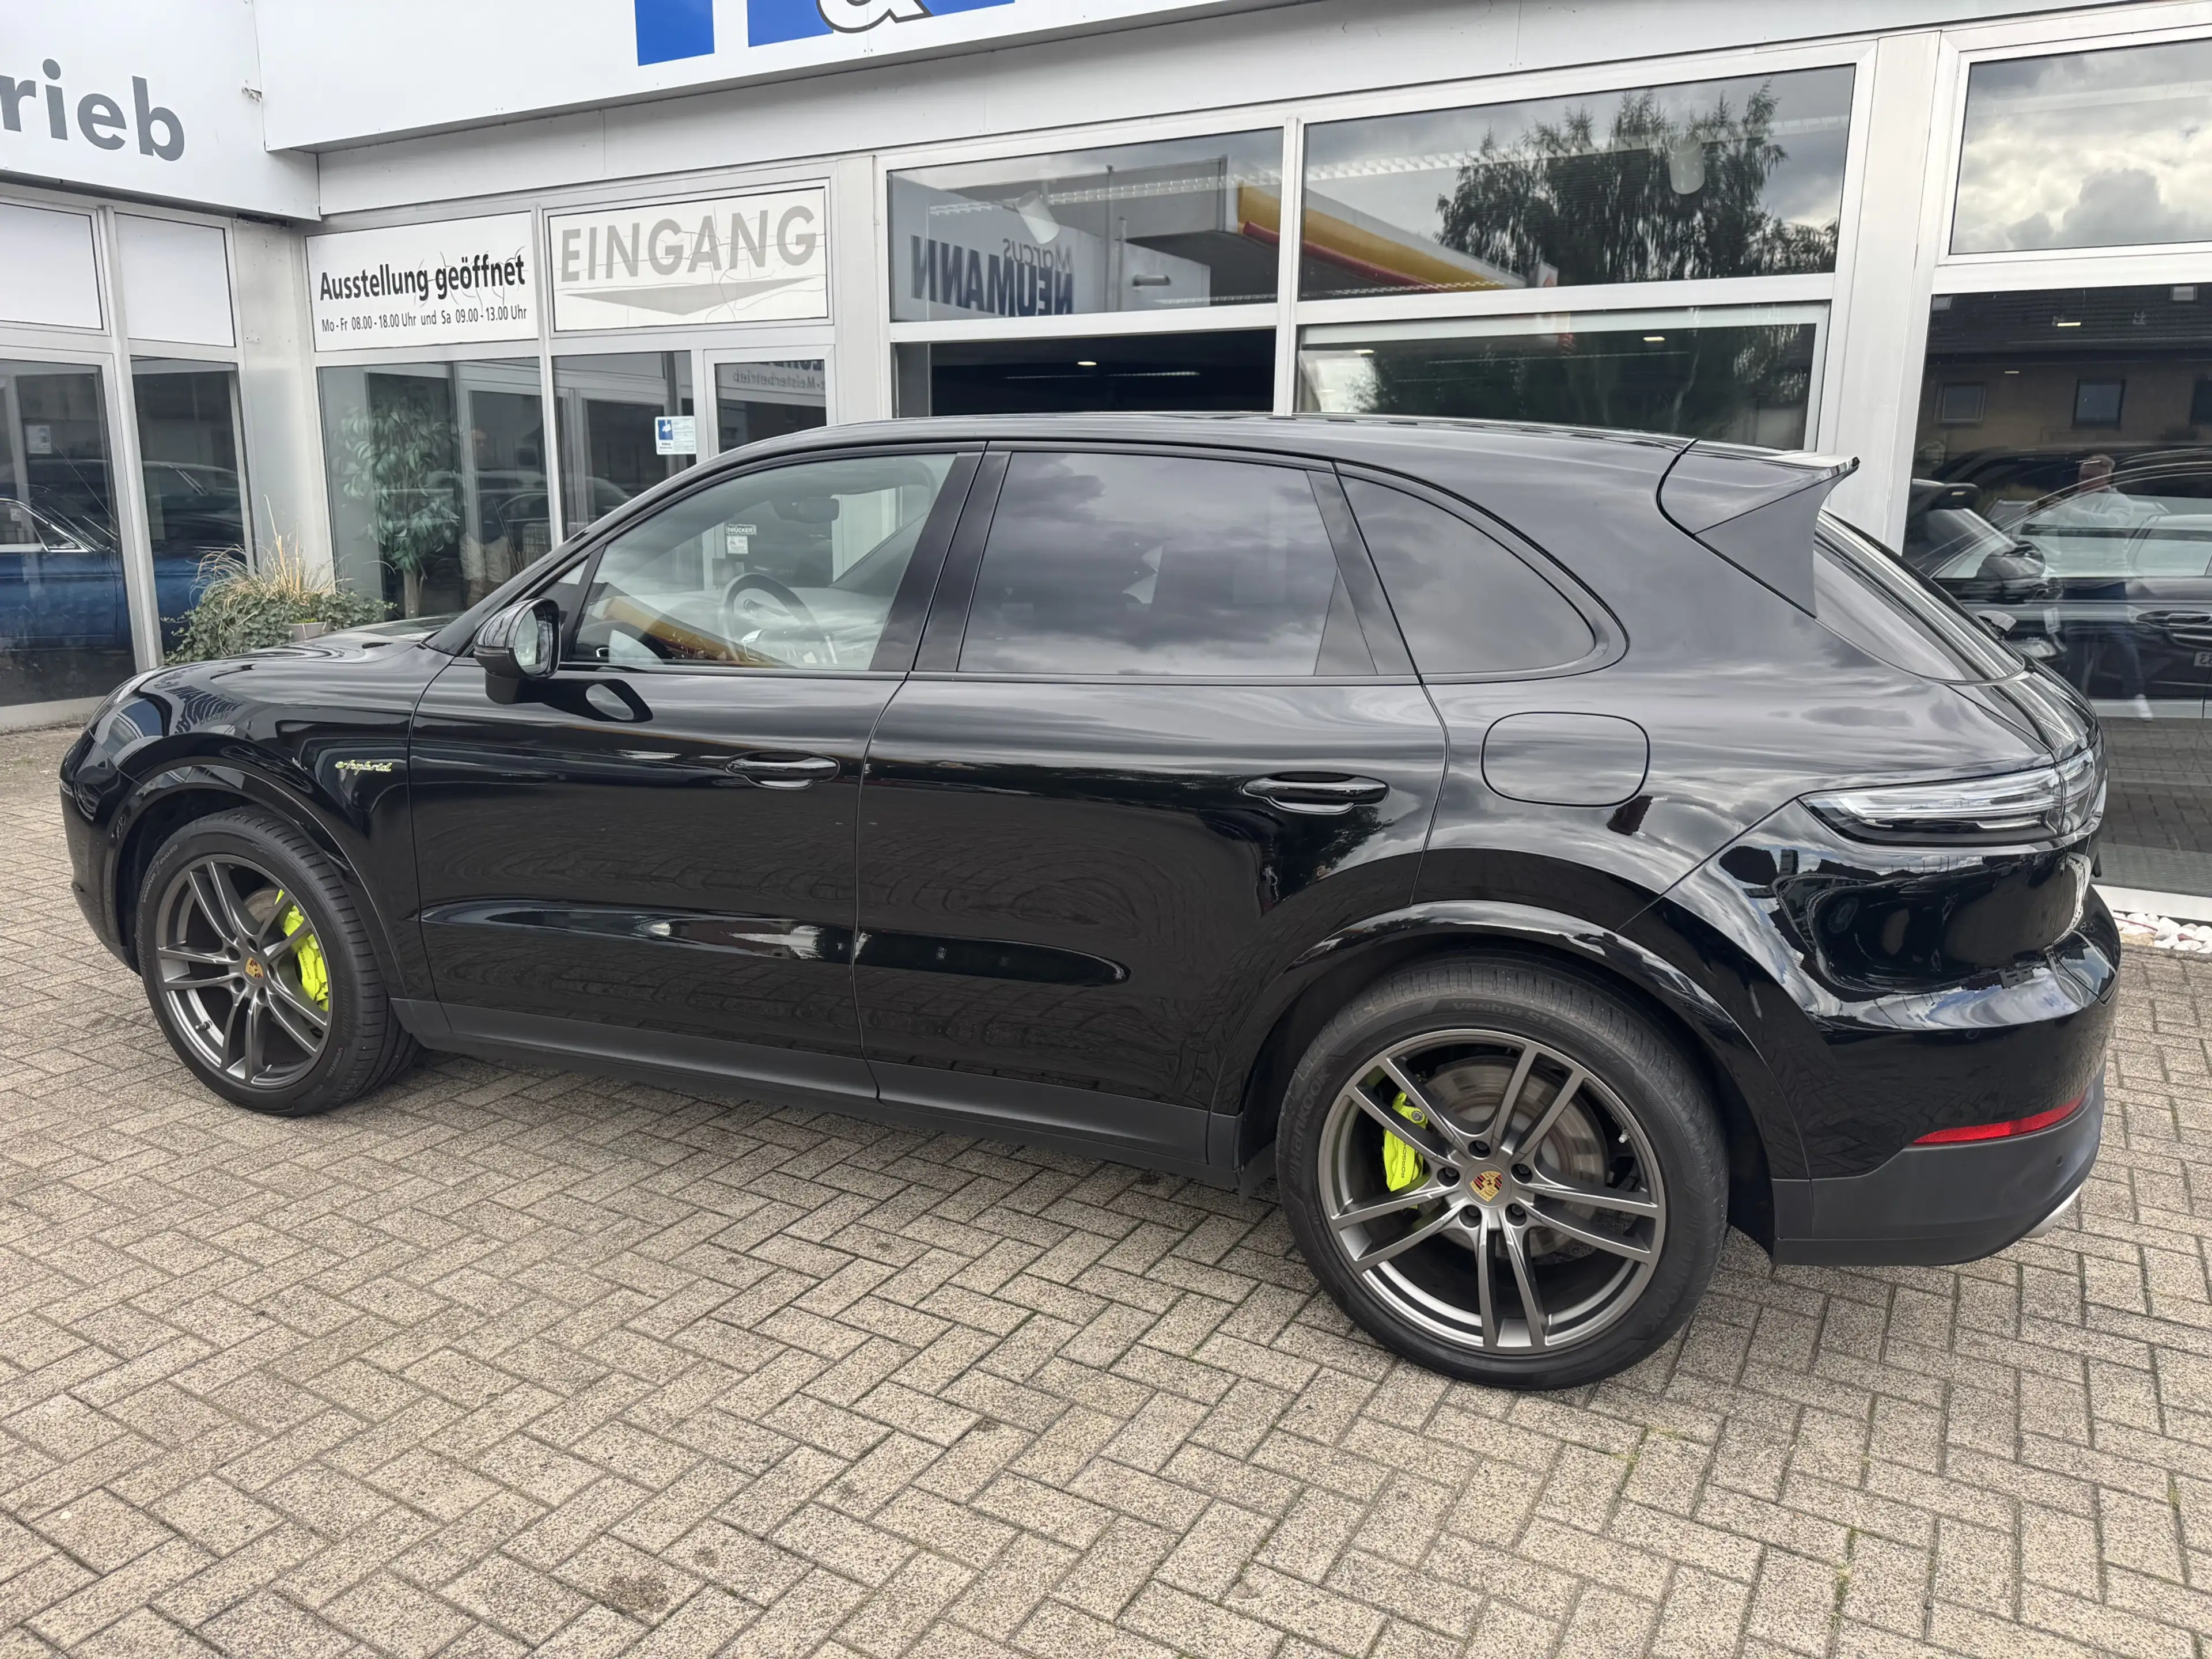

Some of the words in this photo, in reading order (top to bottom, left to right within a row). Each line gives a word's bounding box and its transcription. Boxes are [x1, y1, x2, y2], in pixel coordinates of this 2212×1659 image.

[0, 58, 185, 162] rieb
[561, 205, 817, 282] EINGANG
[320, 263, 429, 301] Ausstellung
[435, 253, 526, 300] geöffnet
[321, 318, 335, 332] Mo
[340, 317, 348, 331] Fr
[351, 316, 373, 331] 08.00
[378, 312, 400, 328] 18.00
[401, 313, 416, 328] Uhr
[421, 310, 437, 326] und
[441, 310, 452, 324] Sa
[456, 308, 479, 324] 09.00
[486, 305, 509, 321] 13.00
[510, 305, 527, 320] Uhr
[335, 760, 393, 776] e-hybrid
